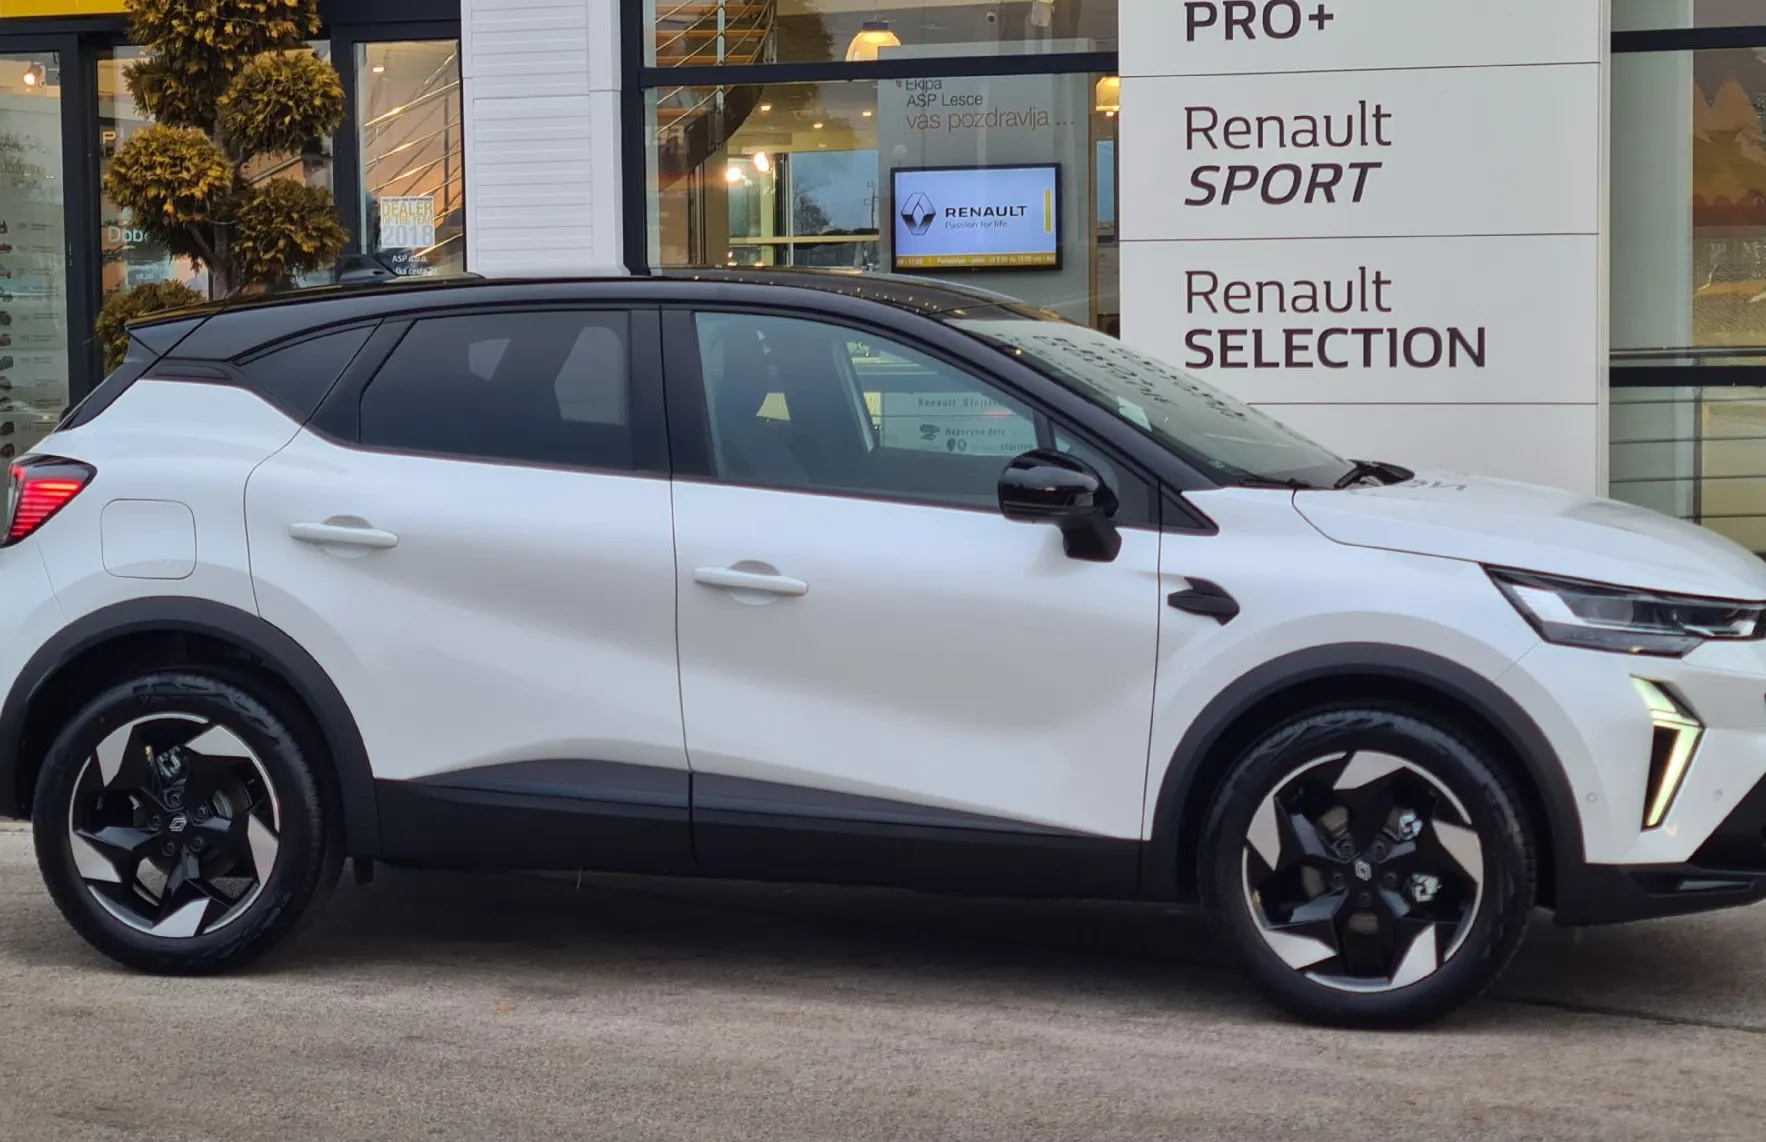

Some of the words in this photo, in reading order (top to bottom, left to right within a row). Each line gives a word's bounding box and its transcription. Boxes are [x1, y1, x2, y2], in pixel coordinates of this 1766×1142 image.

[1184, 0, 1334, 41] PRO+
[905, 79, 942, 92] Ekipa
[942, 94, 983, 107] Lesce
[906, 113, 940, 130] vas
[948, 107, 1049, 132] pozdravlja
[1184, 100, 1392, 150] Renault
[1184, 162, 1383, 206] SPORT
[383, 202, 433, 216] DEALER
[945, 205, 1028, 218] RENAULT
[383, 225, 434, 246] 2018
[945, 220, 978, 229] Passion
[980, 220, 992, 228] for
[994, 219, 1008, 228] life
[1184, 266, 1392, 313] Renault
[1184, 327, 1486, 369] SELECTION
